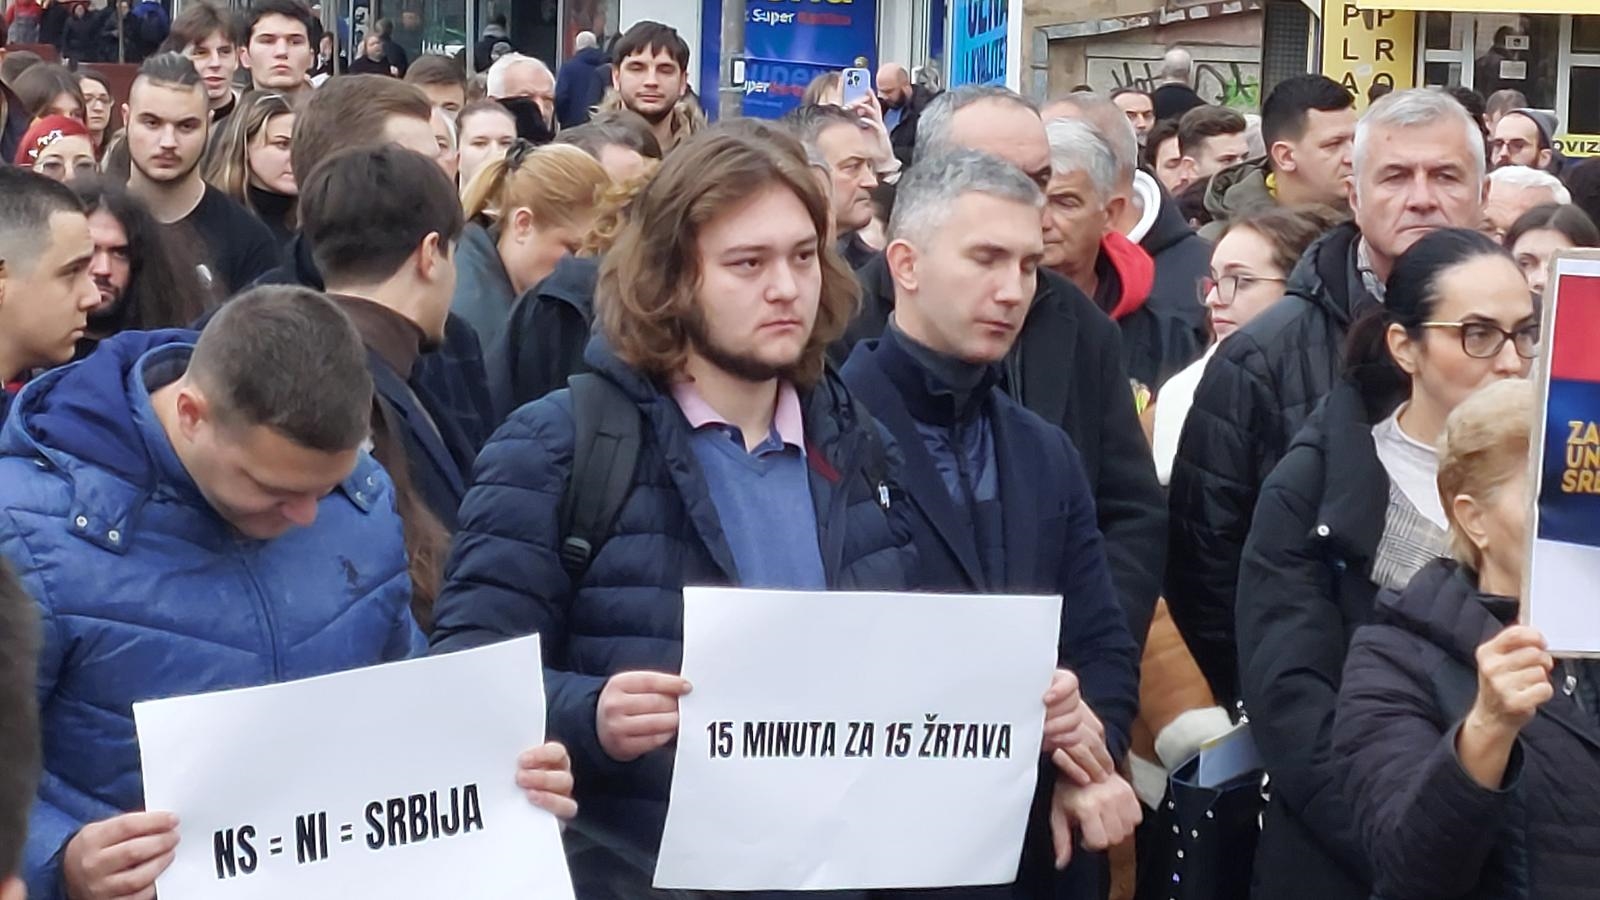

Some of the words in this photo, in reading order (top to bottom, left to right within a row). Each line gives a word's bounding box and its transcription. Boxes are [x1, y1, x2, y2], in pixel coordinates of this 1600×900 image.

[752, 9, 795, 26] Super
[707, 721, 733, 758] 15
[743, 721, 836, 758] MINUTA
[844, 722, 874, 758] ZA
[885, 722, 913, 757] 15
[918, 713, 1011, 759] ŽRTAVA
[213, 825, 258, 879] NS
[270, 836, 282, 855] =
[295, 811, 328, 864] NI
[340, 823, 353, 842] =
[365, 783, 484, 850] SRBIJA
